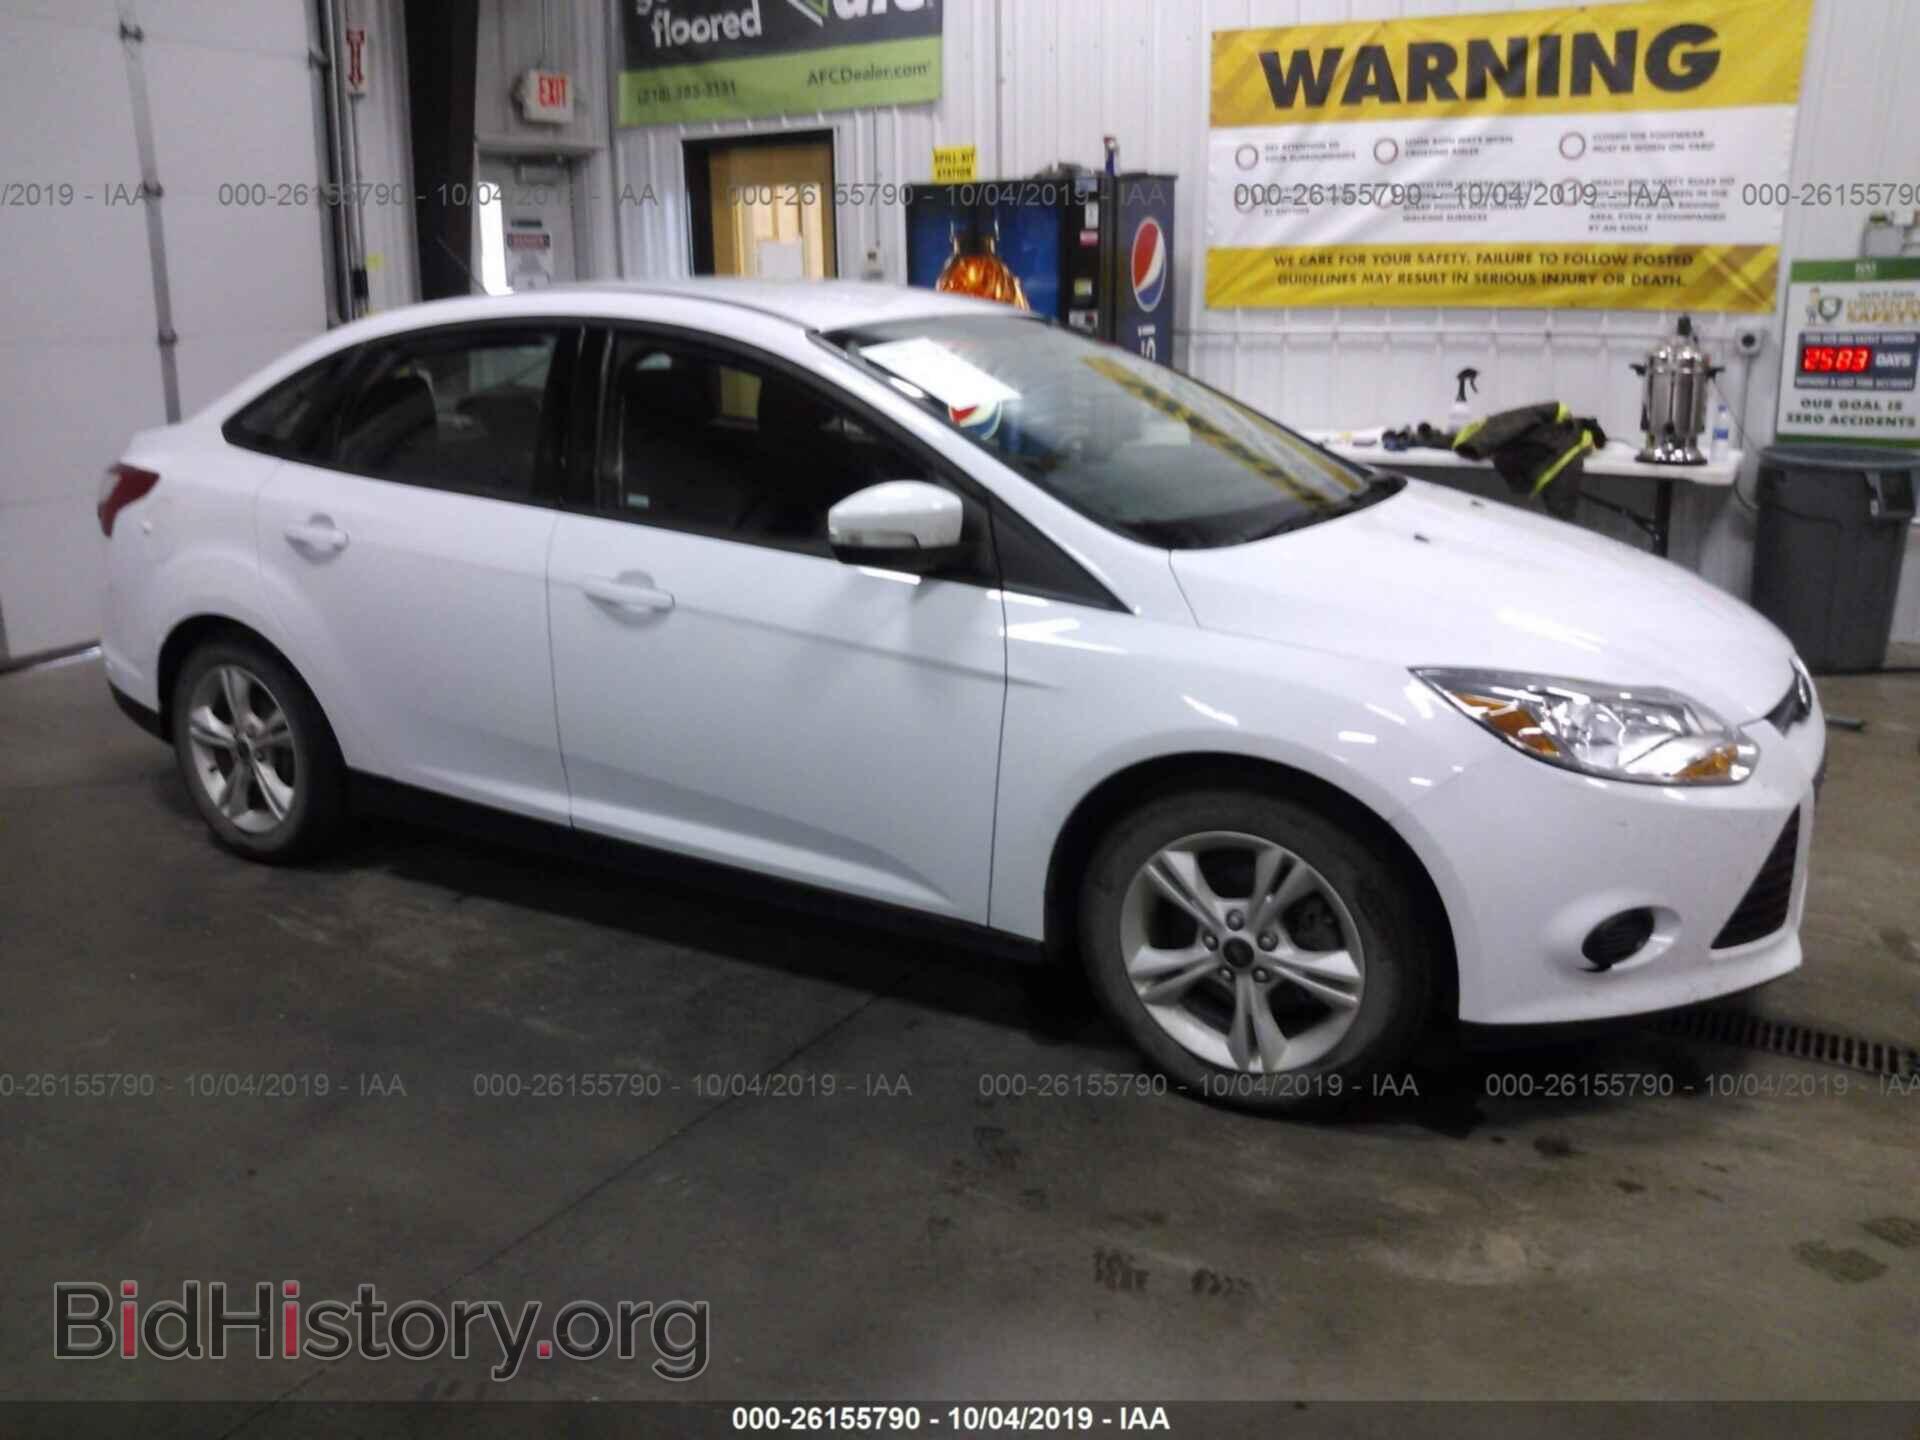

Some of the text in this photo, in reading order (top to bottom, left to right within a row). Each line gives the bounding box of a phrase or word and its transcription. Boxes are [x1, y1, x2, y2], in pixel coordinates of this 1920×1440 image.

[652, 0, 762, 48] floored
[1258, 23, 1721, 111] WARNING
[538, 74, 567, 108] EXIT
[1273, 255, 1293, 266] WE
[1299, 254, 1333, 266] CARE
[1339, 254, 1366, 266] FOR
[1372, 253, 1412, 265] YOUR
[1476, 253, 1532, 265] FAILURE
[1539, 253, 1558, 265] TO
[1564, 253, 1628, 265] FOLLOW
[1634, 253, 1693, 266] POSTED
[1278, 272, 1356, 285] GUIDELINES
[1361, 272, 1392, 285] MAY
[1398, 272, 1447, 285] RESULT
[1452, 272, 1468, 284] IN
[1474, 272, 1536, 285] SERIOUS
[1542, 272, 1597, 285] INJURY
[1603, 272, 1626, 285] OR
[1875, 353, 1912, 367] DAYS
[1801, 399, 1903, 411] OUR GOAL IS
[1787, 413, 1916, 428] ZERO ACCIDENTS
